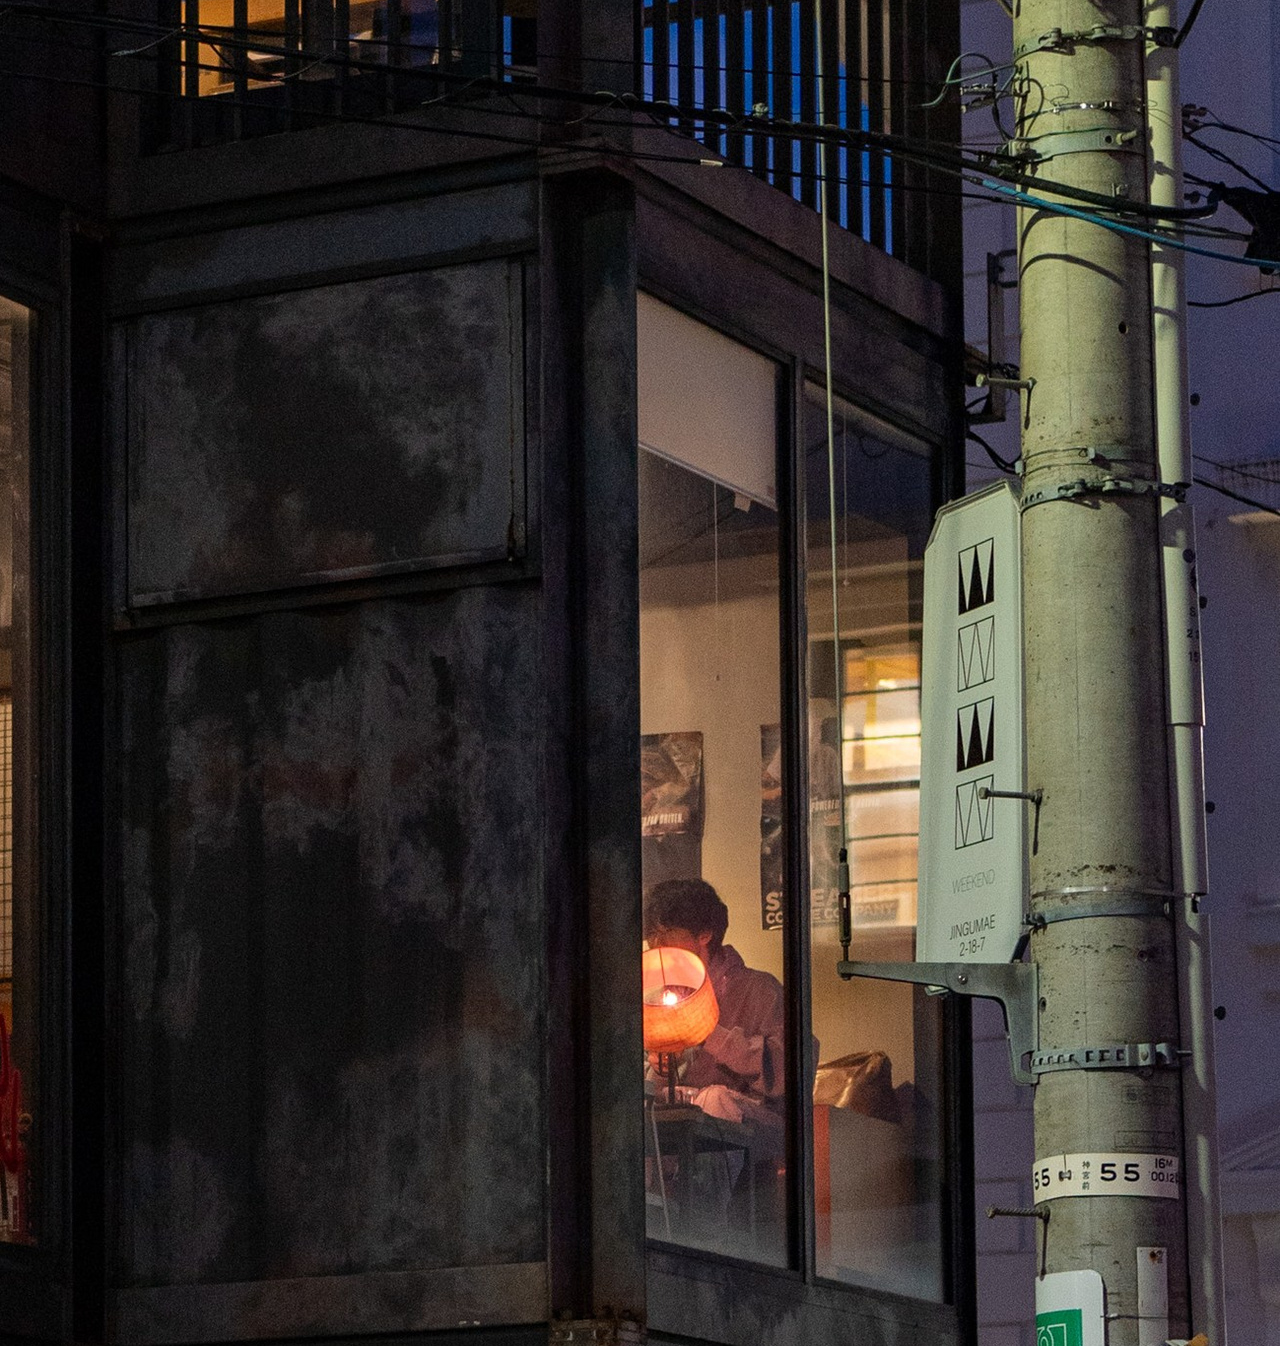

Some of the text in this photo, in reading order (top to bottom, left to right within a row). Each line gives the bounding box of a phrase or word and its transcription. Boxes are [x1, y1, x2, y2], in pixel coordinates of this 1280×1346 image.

[952, 868, 996, 894] WEEKEND
[950, 914, 995, 940] JINGUMAE
[959, 936, 986, 957] 2-18-7
[1100, 1163, 1140, 1182] 55
